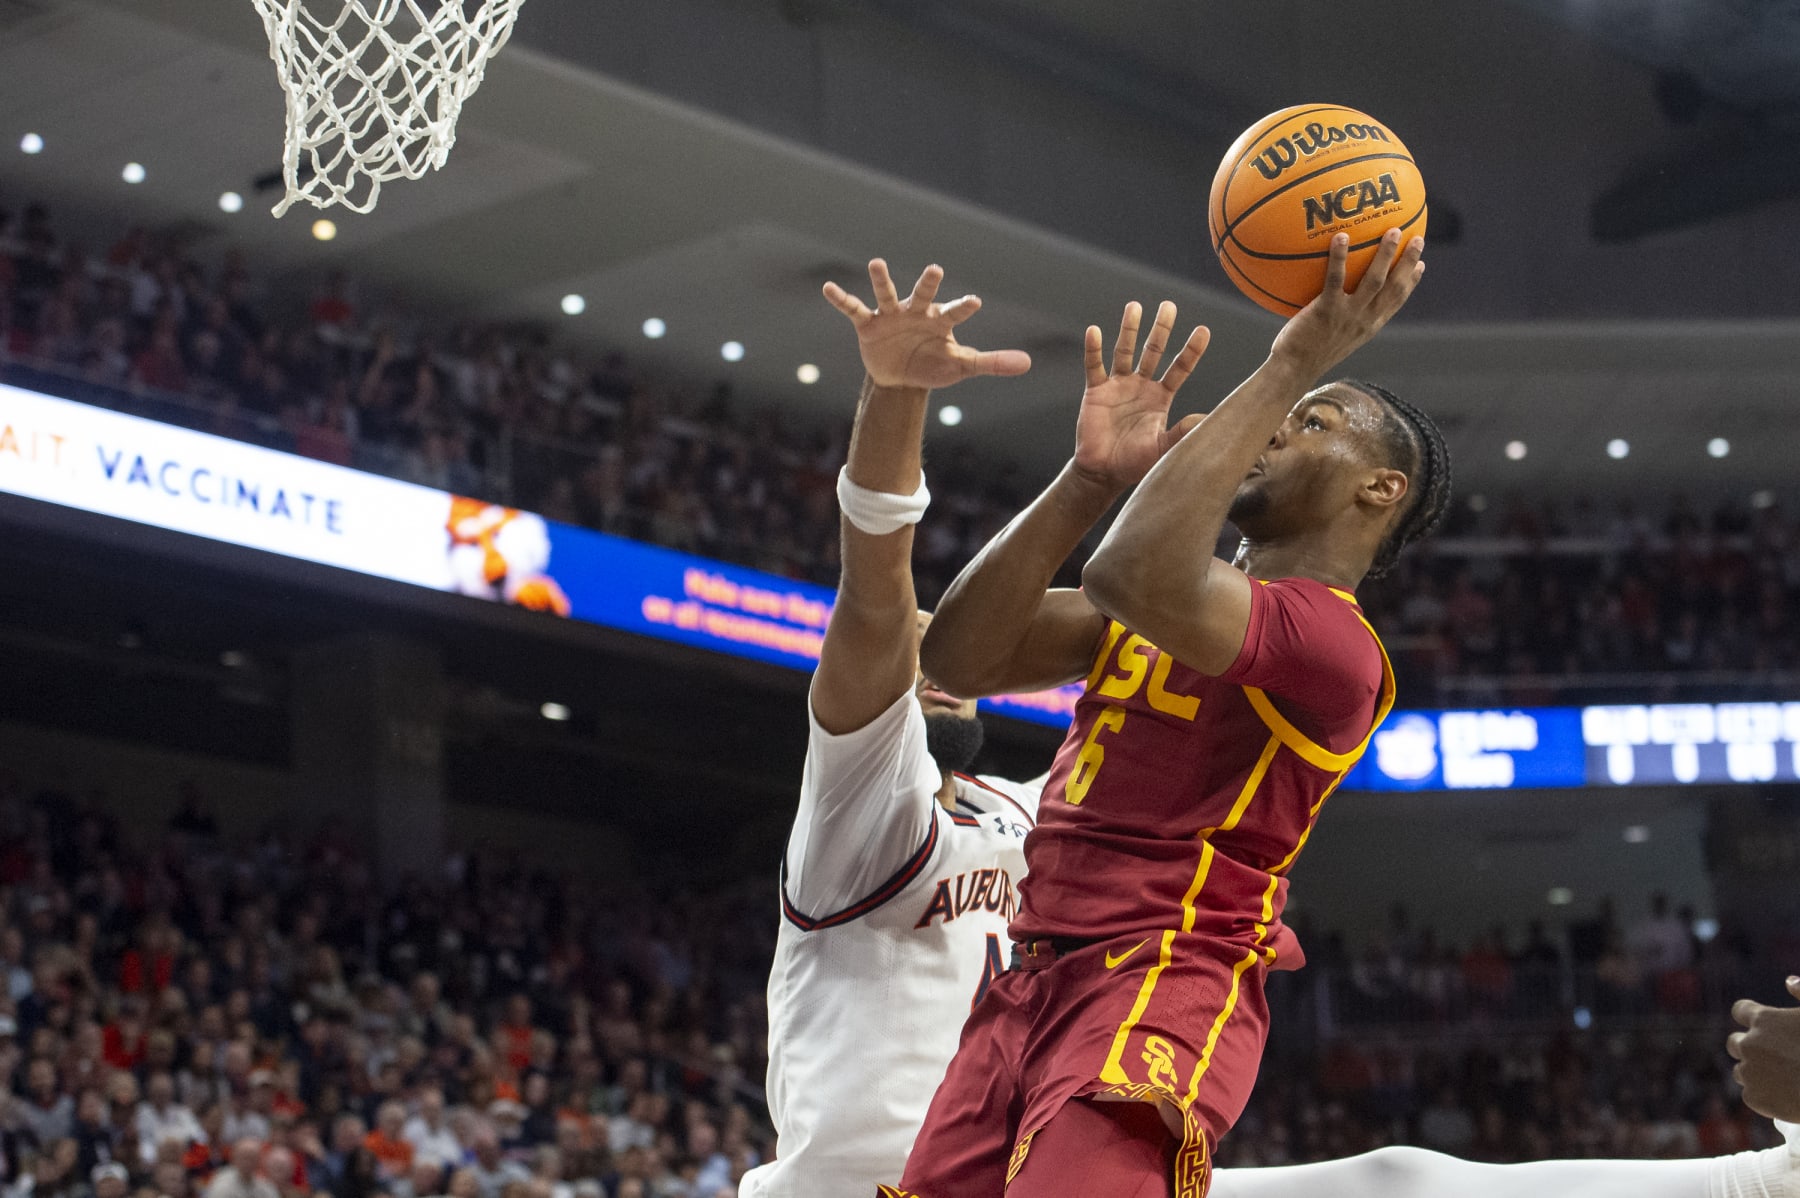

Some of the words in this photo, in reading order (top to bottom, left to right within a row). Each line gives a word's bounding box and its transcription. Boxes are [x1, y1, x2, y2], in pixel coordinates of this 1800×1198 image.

[1249, 122, 1391, 180] Wilson
[1303, 172, 1400, 232] NCAA
[1307, 222, 1353, 240] OFFICIAL
[1354, 212, 1382, 226] GAME
[1382, 206, 1403, 217] BALL
[97, 445, 344, 534] VACCINATE
[1065, 705, 1126, 806] 6
